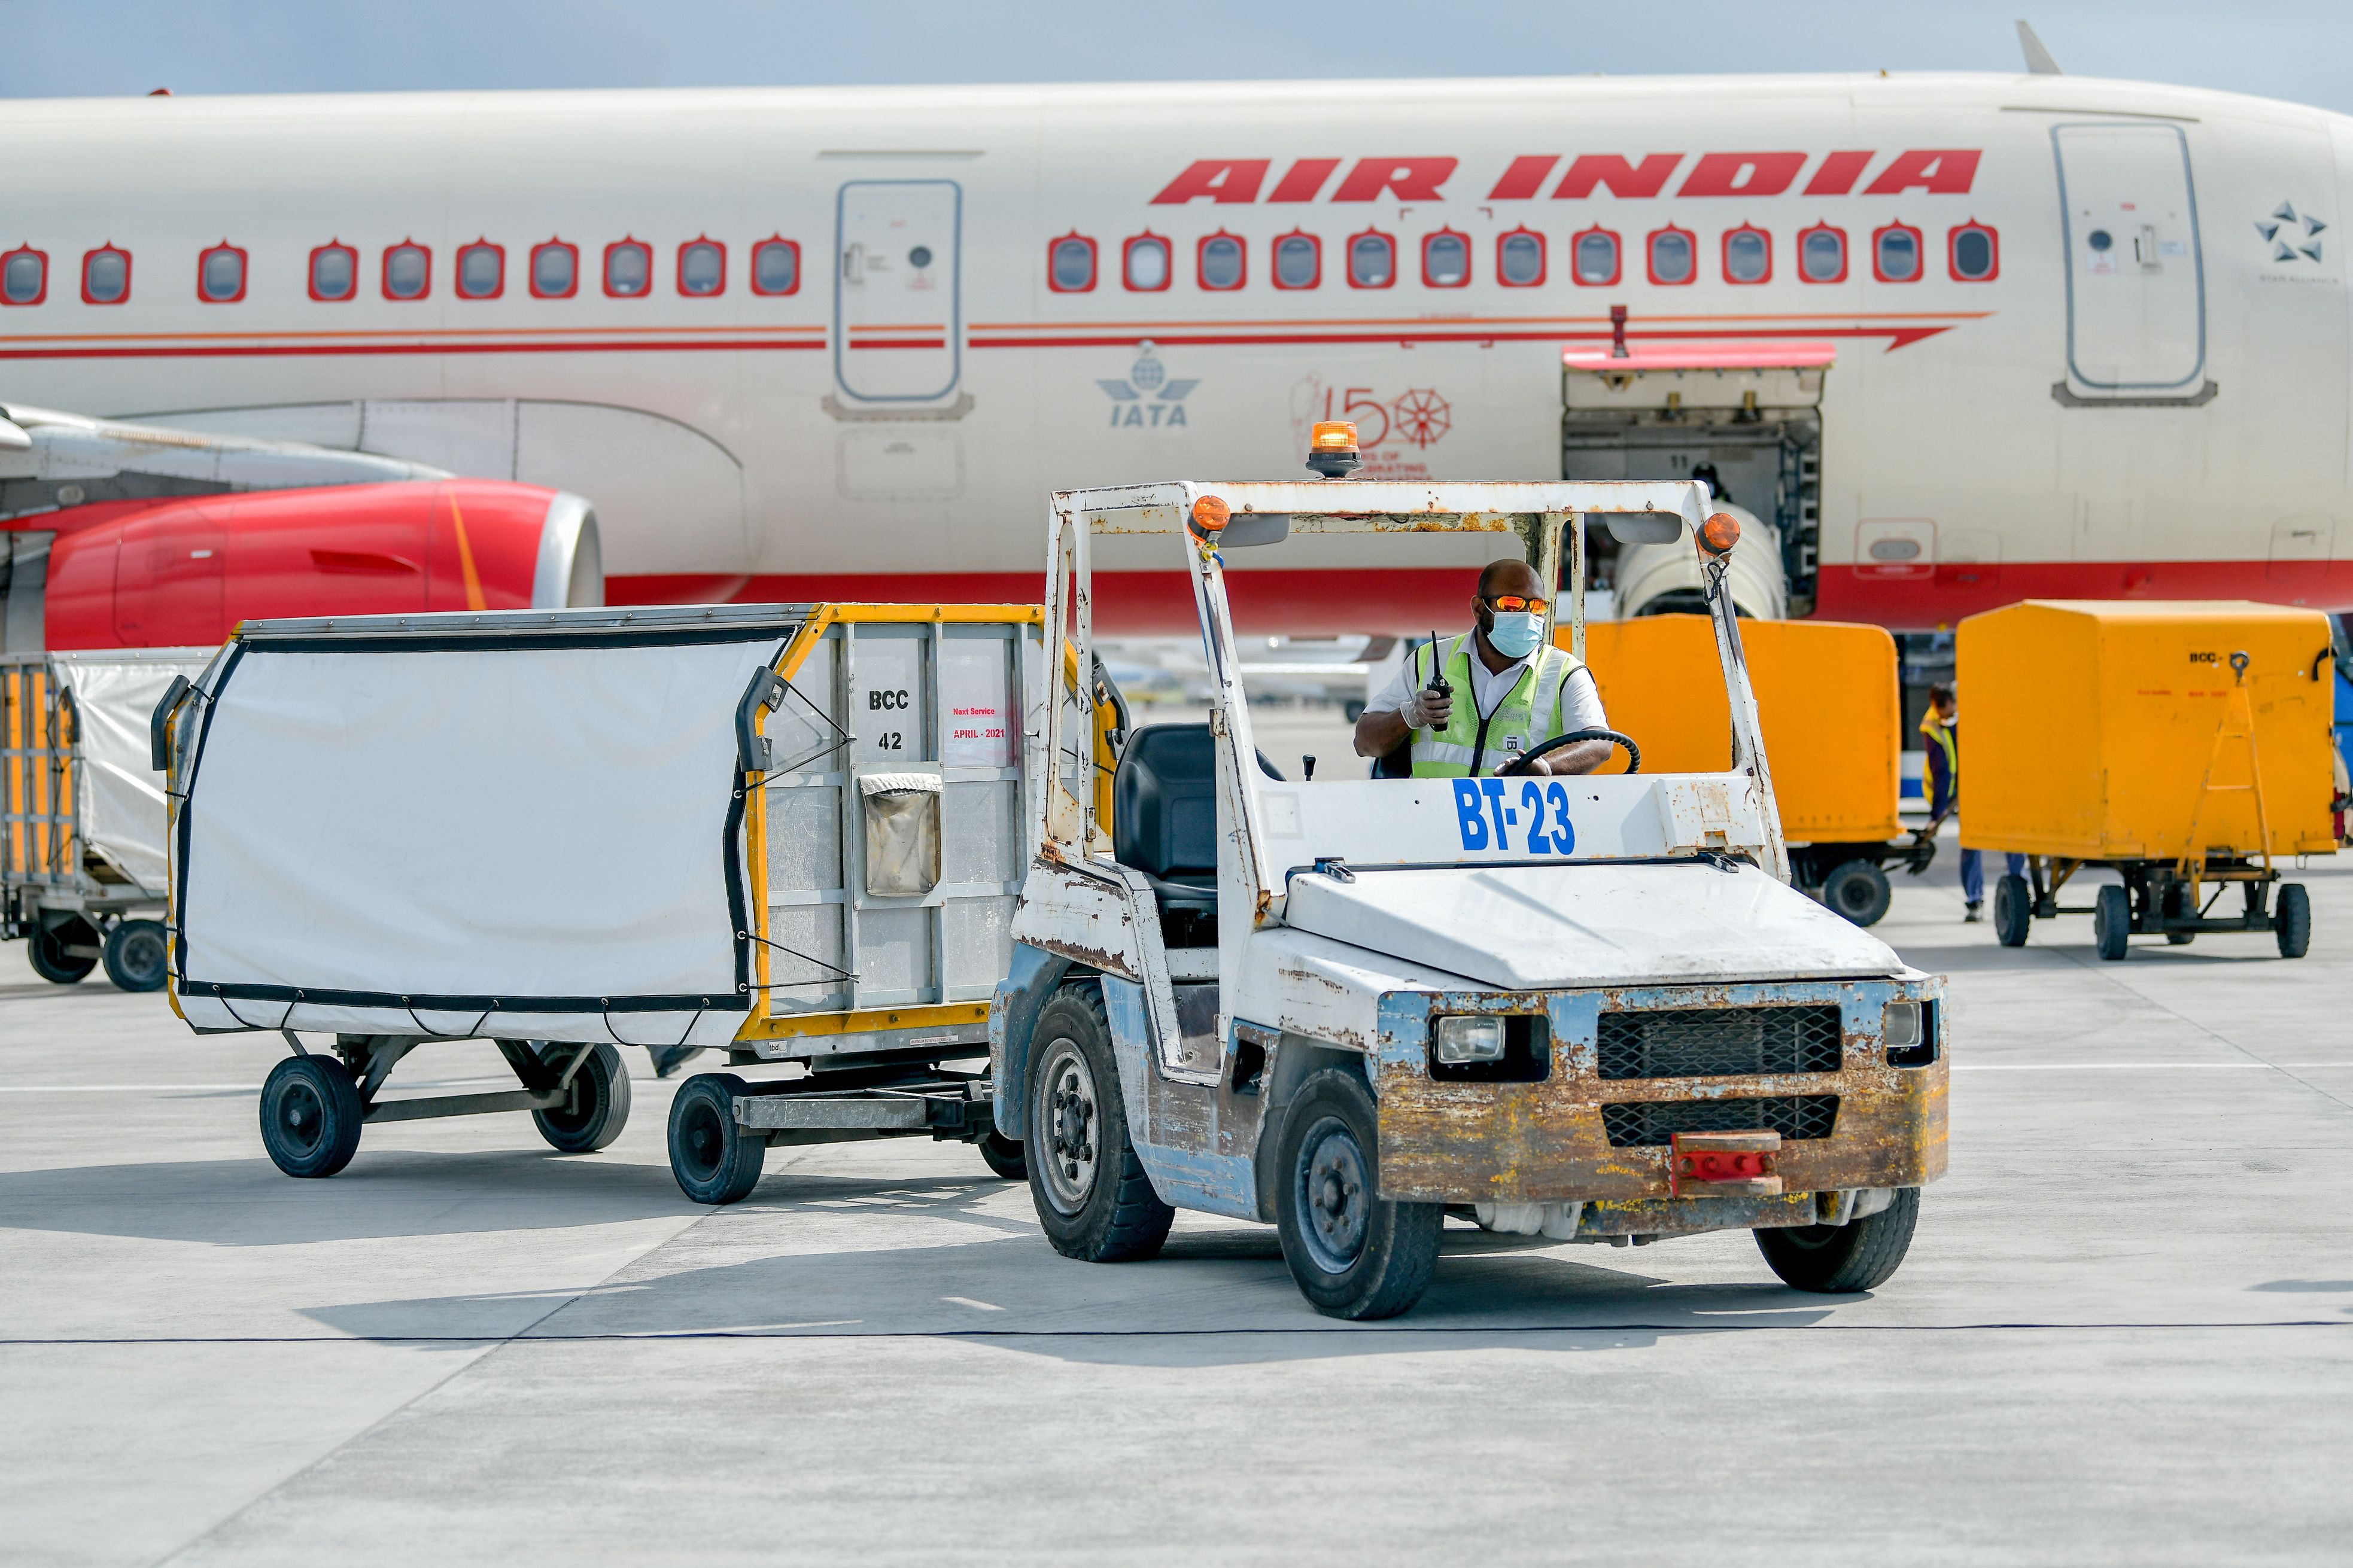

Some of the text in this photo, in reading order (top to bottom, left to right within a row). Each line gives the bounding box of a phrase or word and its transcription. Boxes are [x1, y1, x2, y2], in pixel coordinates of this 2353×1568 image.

[1148, 150, 1983, 205] AIR INDIA
[1111, 404, 1188, 427] IATA
[870, 690, 908, 710] BCC
[878, 732, 902, 750] 42
[954, 729, 978, 738] APRIL
[986, 729, 1005, 738] 2021
[1452, 778, 1576, 855] BT-23
